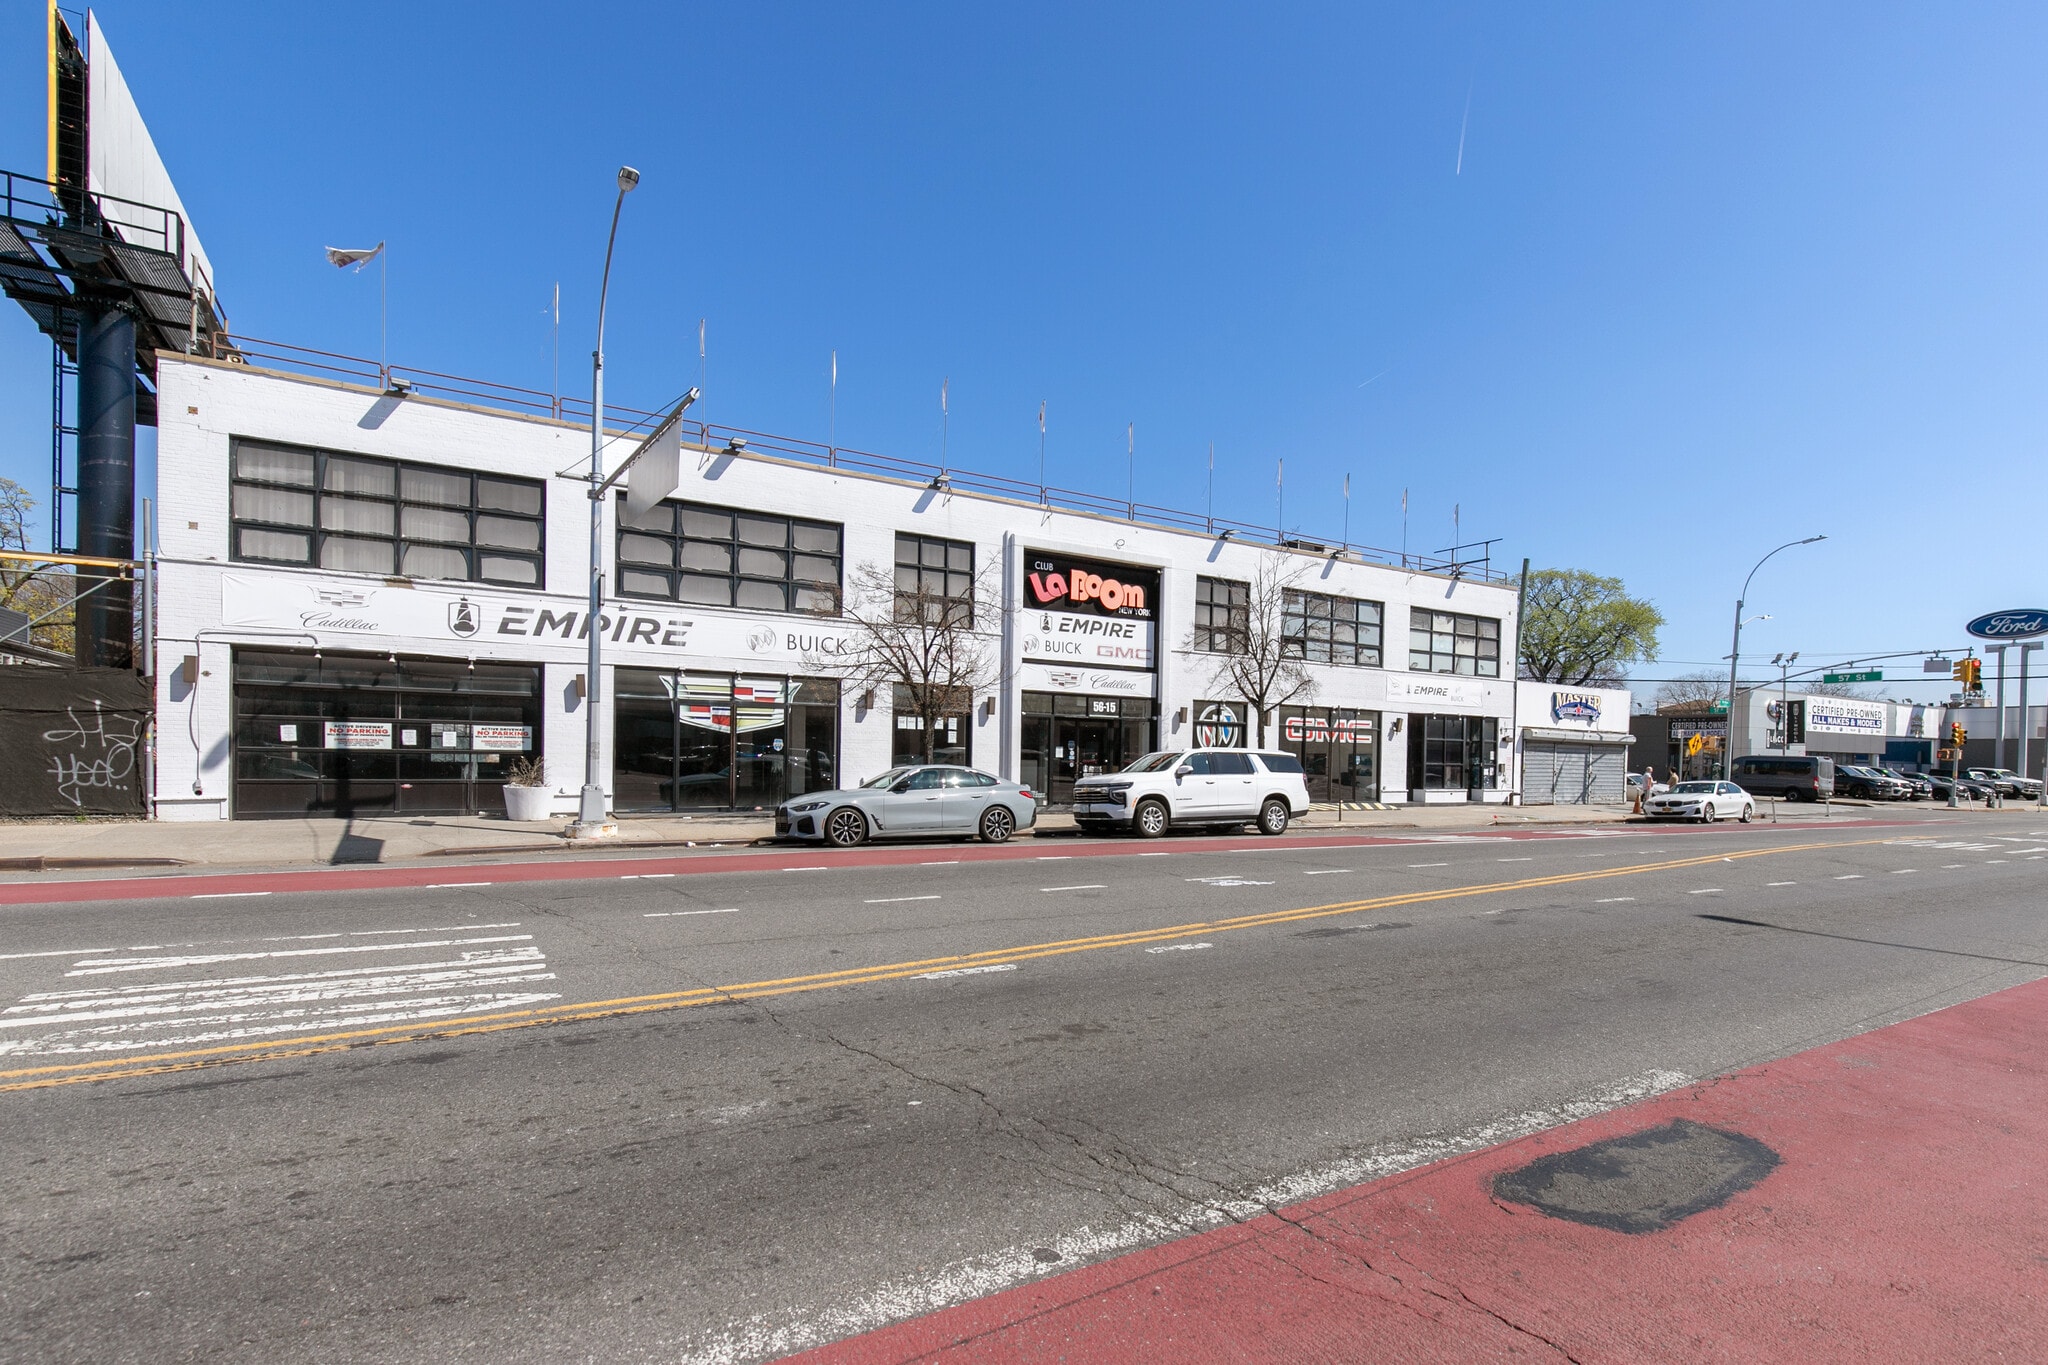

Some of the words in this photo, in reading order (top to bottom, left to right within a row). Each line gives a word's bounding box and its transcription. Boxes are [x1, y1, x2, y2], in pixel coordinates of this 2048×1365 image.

[1034, 561, 1054, 571] CLUB
[300, 611, 379, 631] Cadillac
[1118, 607, 1133, 615] NEW
[1135, 608, 1151, 617] YORK
[497, 606, 694, 647] EMPIRE
[1058, 617, 1136, 639] EMPIRE
[1985, 614, 2043, 635] Ford
[786, 633, 848, 655] BUICK
[1045, 640, 1082, 655] BUICK
[1097, 645, 1153, 660] GMC
[1090, 674, 1136, 691] Cadillac
[1838, 674, 1850, 682] 57
[1856, 673, 1867, 681] St
[1413, 685, 1448, 697] EMPIRE
[1092, 701, 1117, 714] 56-15
[1556, 692, 1601, 713] MASTER
[1812, 705, 1844, 716] CERTIFIED
[1846, 708, 1883, 720] PRE-OWNED
[1813, 715, 1827, 724] ALL
[1827, 716, 1850, 726] MAKES
[1856, 719, 1881, 728] MODELS
[1285, 716, 1373, 744] GMC
